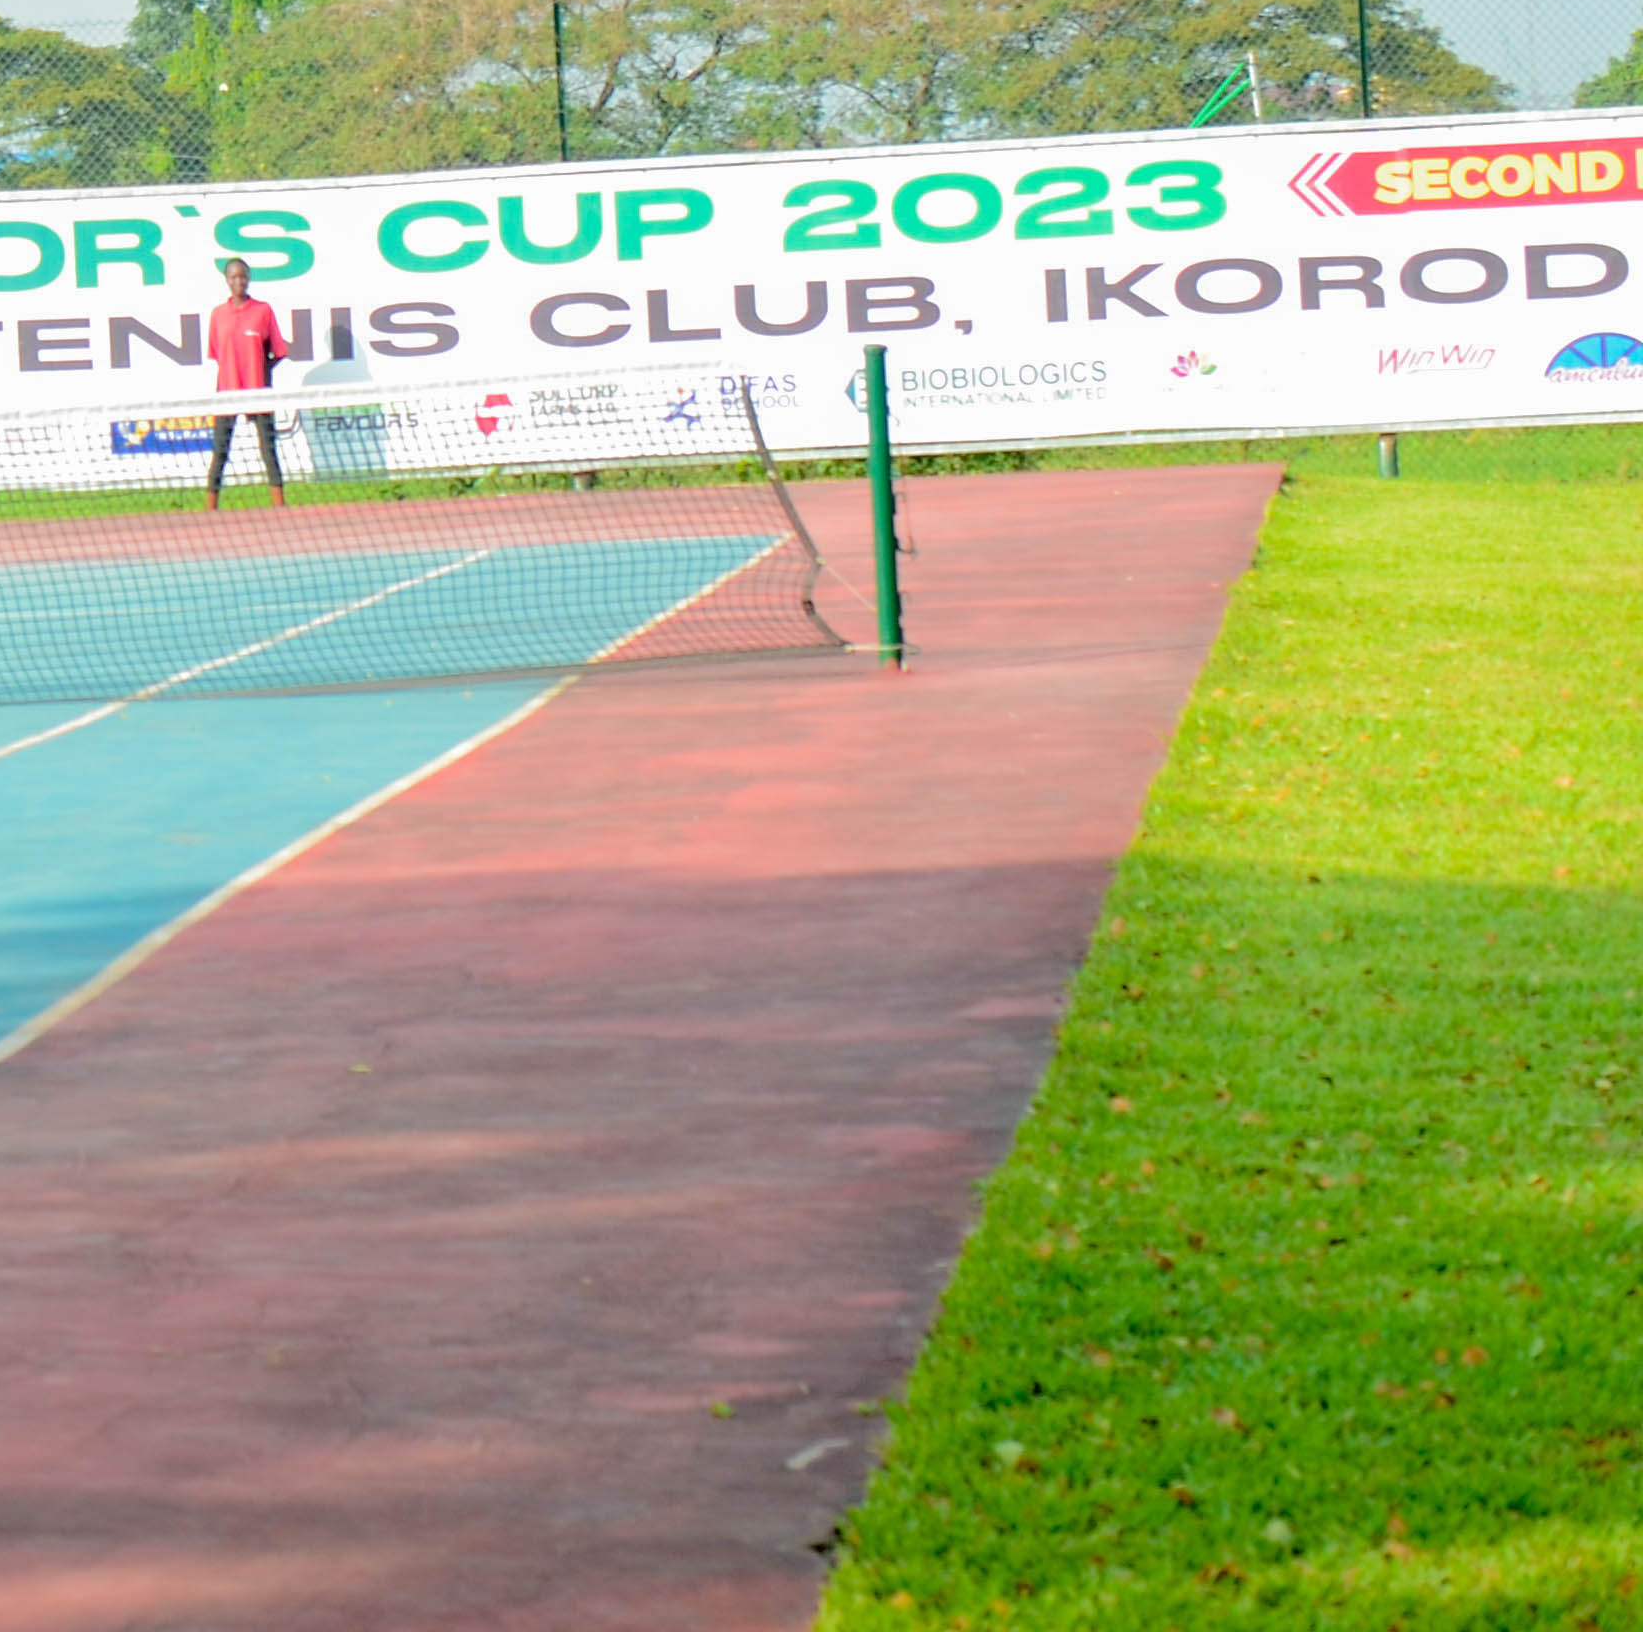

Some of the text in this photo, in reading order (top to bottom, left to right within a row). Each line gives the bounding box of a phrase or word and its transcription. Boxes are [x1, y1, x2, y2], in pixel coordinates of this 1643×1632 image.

[1373, 150, 1624, 205] SECOND
[377, 187, 715, 274] CUP
[783, 160, 1228, 253] 2023
[529, 276, 973, 348] CLUB,
[1044, 243, 1630, 323] IKOROD
[901, 360, 1108, 393] BIOBIOLOGICS
[1378, 344, 1496, 375] Win Win
[719, 374, 797, 395] DFAS
